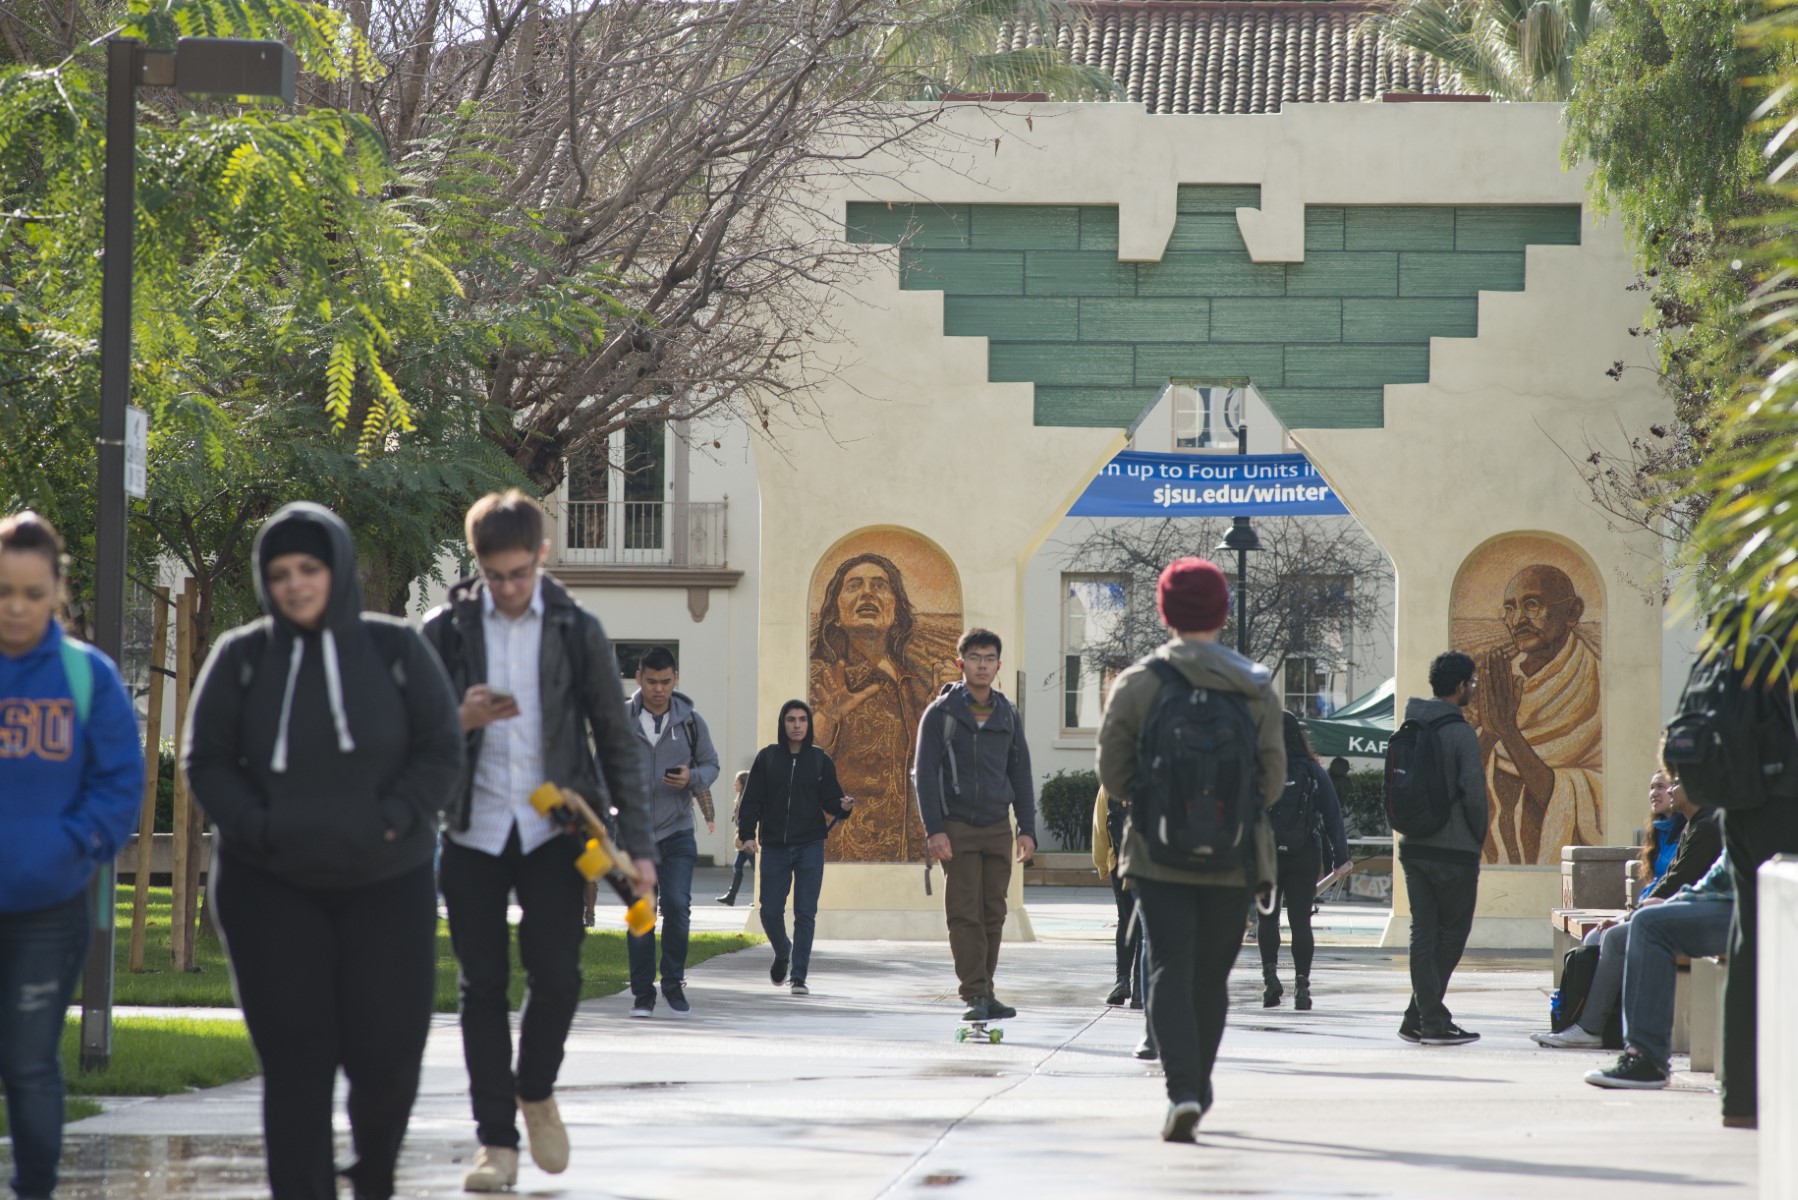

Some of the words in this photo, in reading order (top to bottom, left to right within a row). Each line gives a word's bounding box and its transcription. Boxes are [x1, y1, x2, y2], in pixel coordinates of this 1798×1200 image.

[1127, 464, 1153, 481] up
[1159, 463, 1182, 478] to
[1189, 464, 1237, 479] Four
[1243, 464, 1298, 479] Units
[1153, 483, 1329, 507] sjsu.edu/winter
